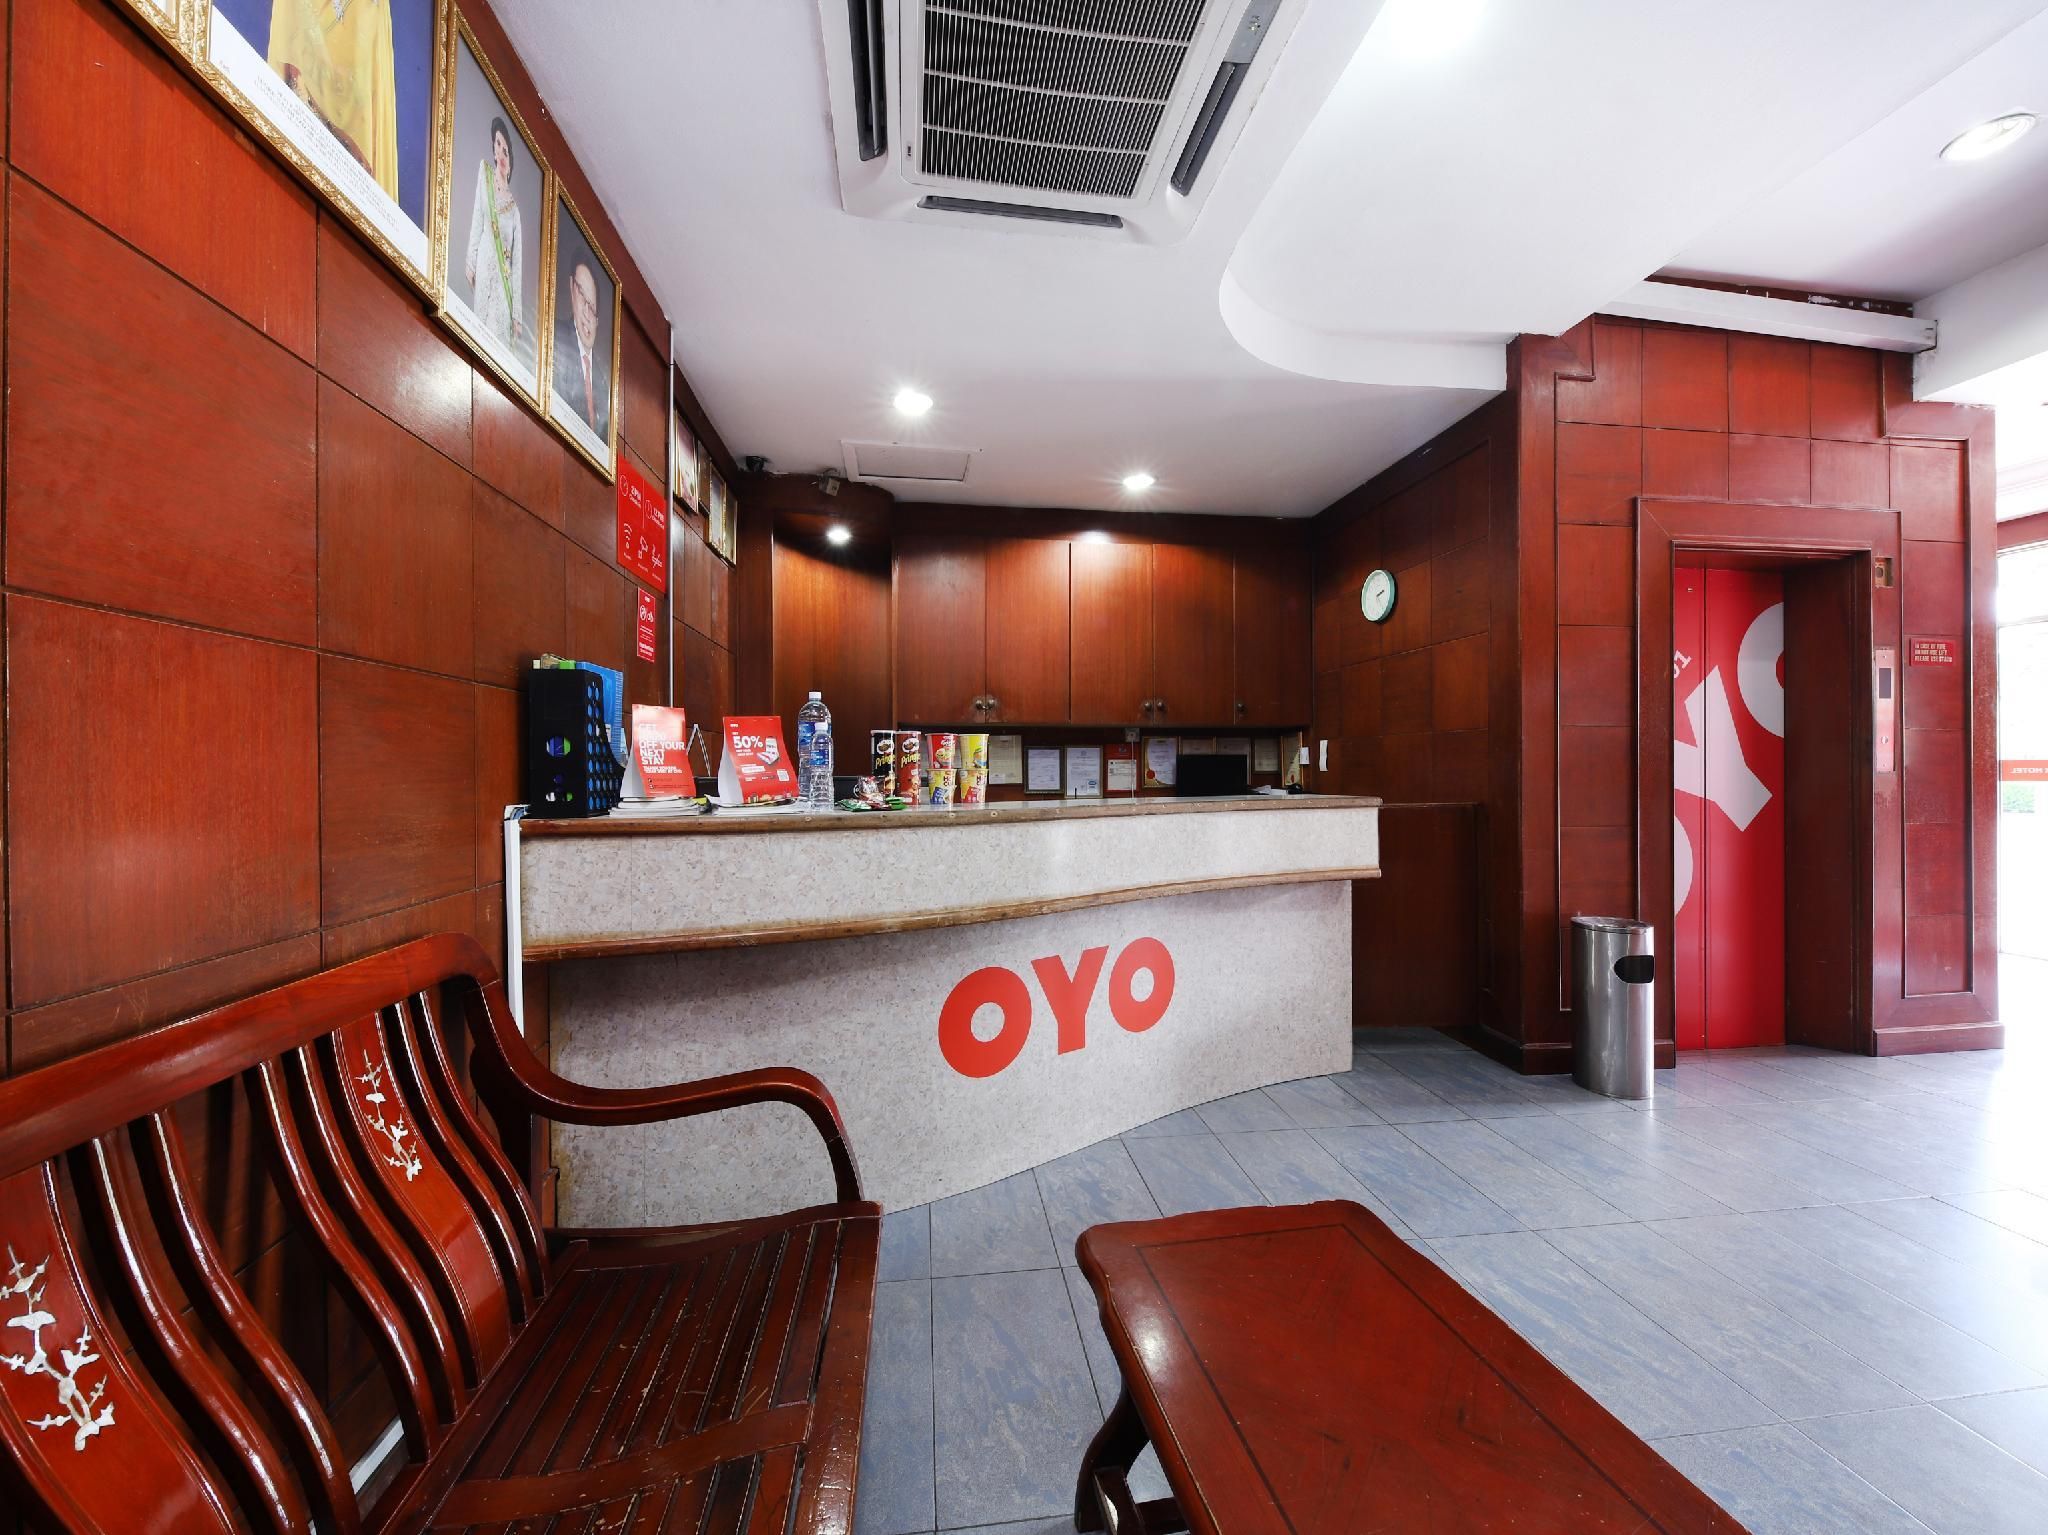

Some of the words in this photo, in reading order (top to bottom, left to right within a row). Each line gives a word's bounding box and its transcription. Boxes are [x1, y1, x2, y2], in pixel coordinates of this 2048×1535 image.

[660, 741, 686, 750] YOUR
[733, 735, 764, 749] 50%
[640, 749, 665, 758] NEXT
[641, 756, 665, 765] STAY
[938, 937, 1175, 1078] OYO
